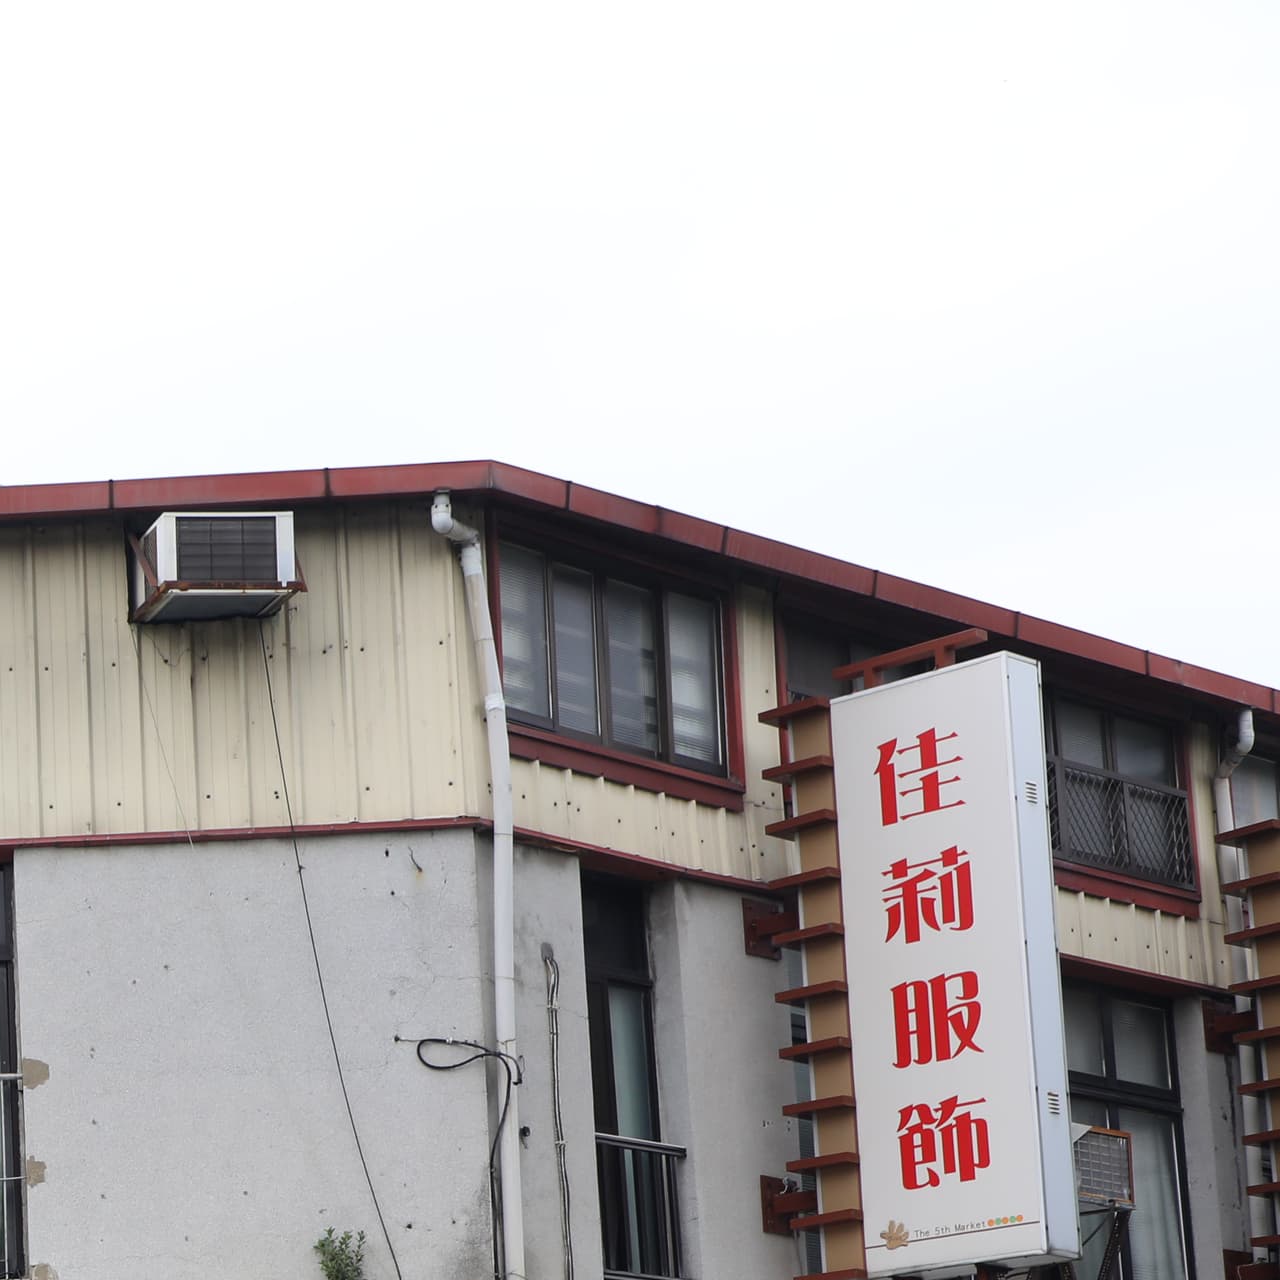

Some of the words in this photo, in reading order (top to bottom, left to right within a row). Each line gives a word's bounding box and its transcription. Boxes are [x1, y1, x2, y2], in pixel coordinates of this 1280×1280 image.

[873, 726, 992, 1191] 佳莉服飾
[914, 1230, 931, 1239] The
[935, 1227, 951, 1236] 5th
[955, 1221, 987, 1232] Market
